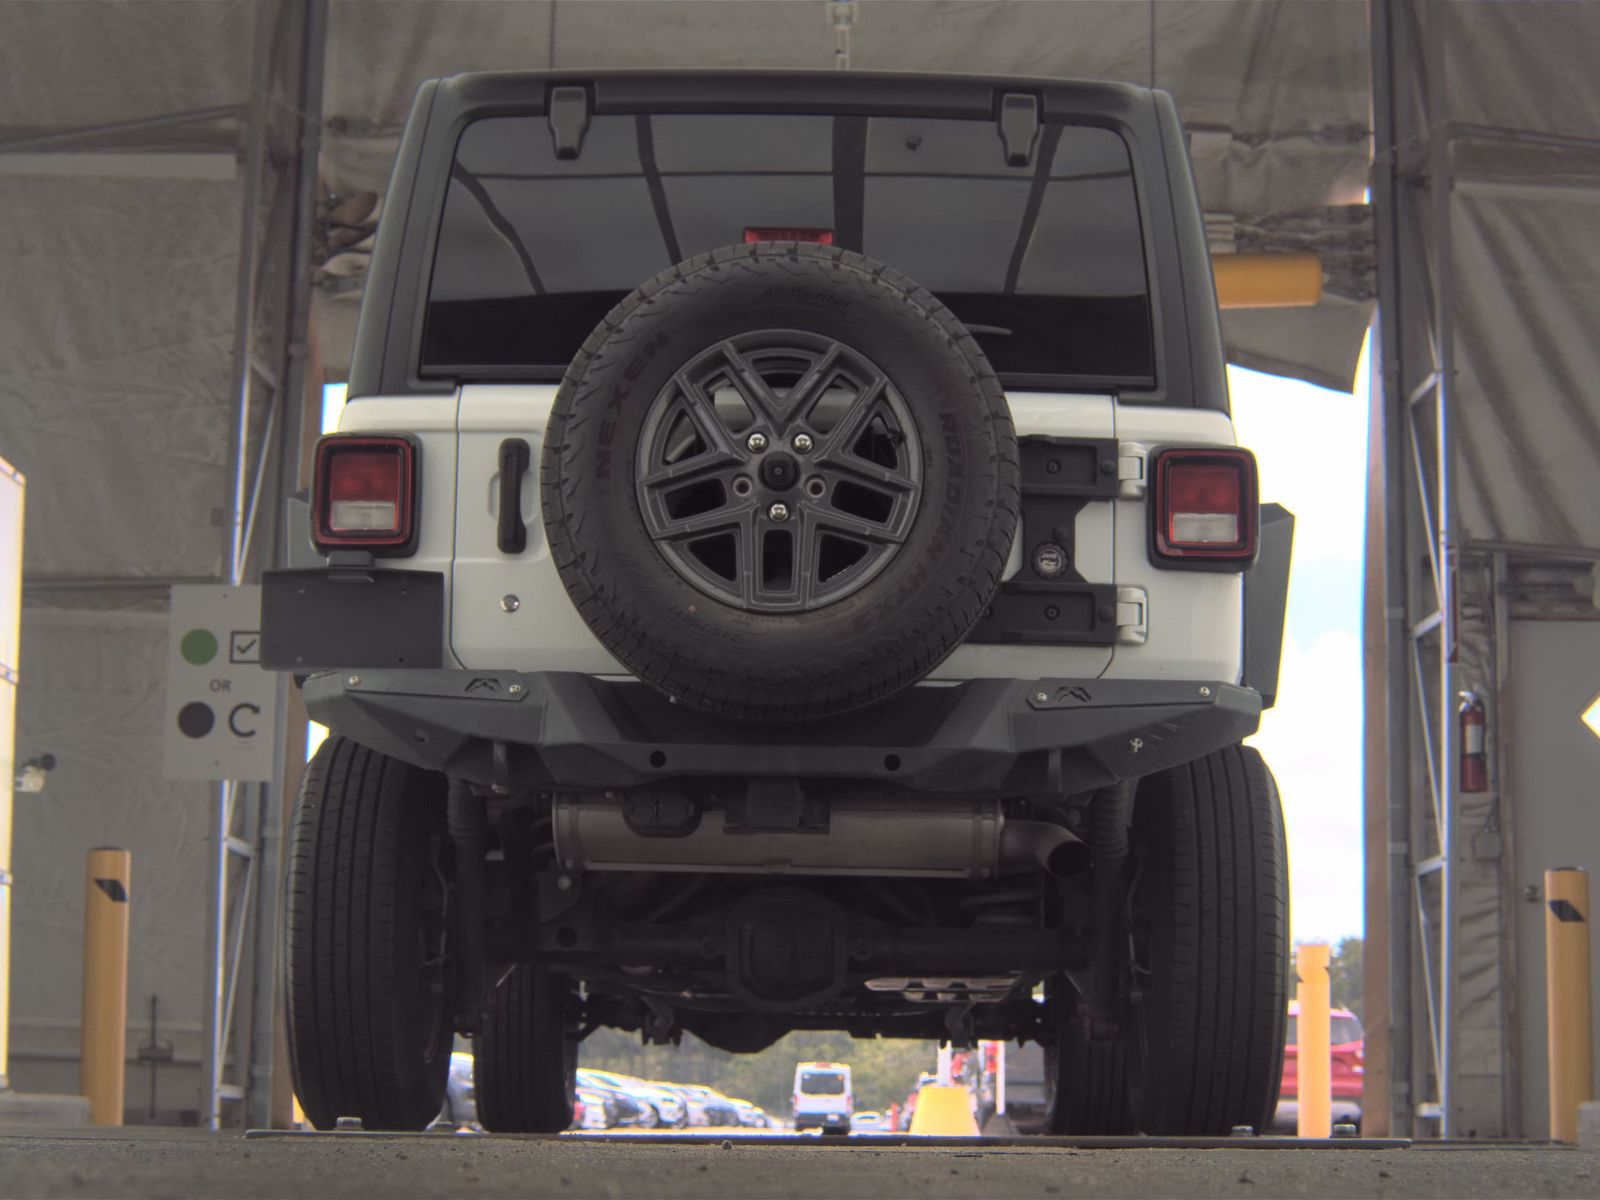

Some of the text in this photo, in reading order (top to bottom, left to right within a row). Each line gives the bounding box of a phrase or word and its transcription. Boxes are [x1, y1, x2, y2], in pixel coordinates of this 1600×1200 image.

[594, 329, 671, 480] NEXEN
[924, 408, 963, 563] ROADIAN
[209, 679, 232, 692] OR
